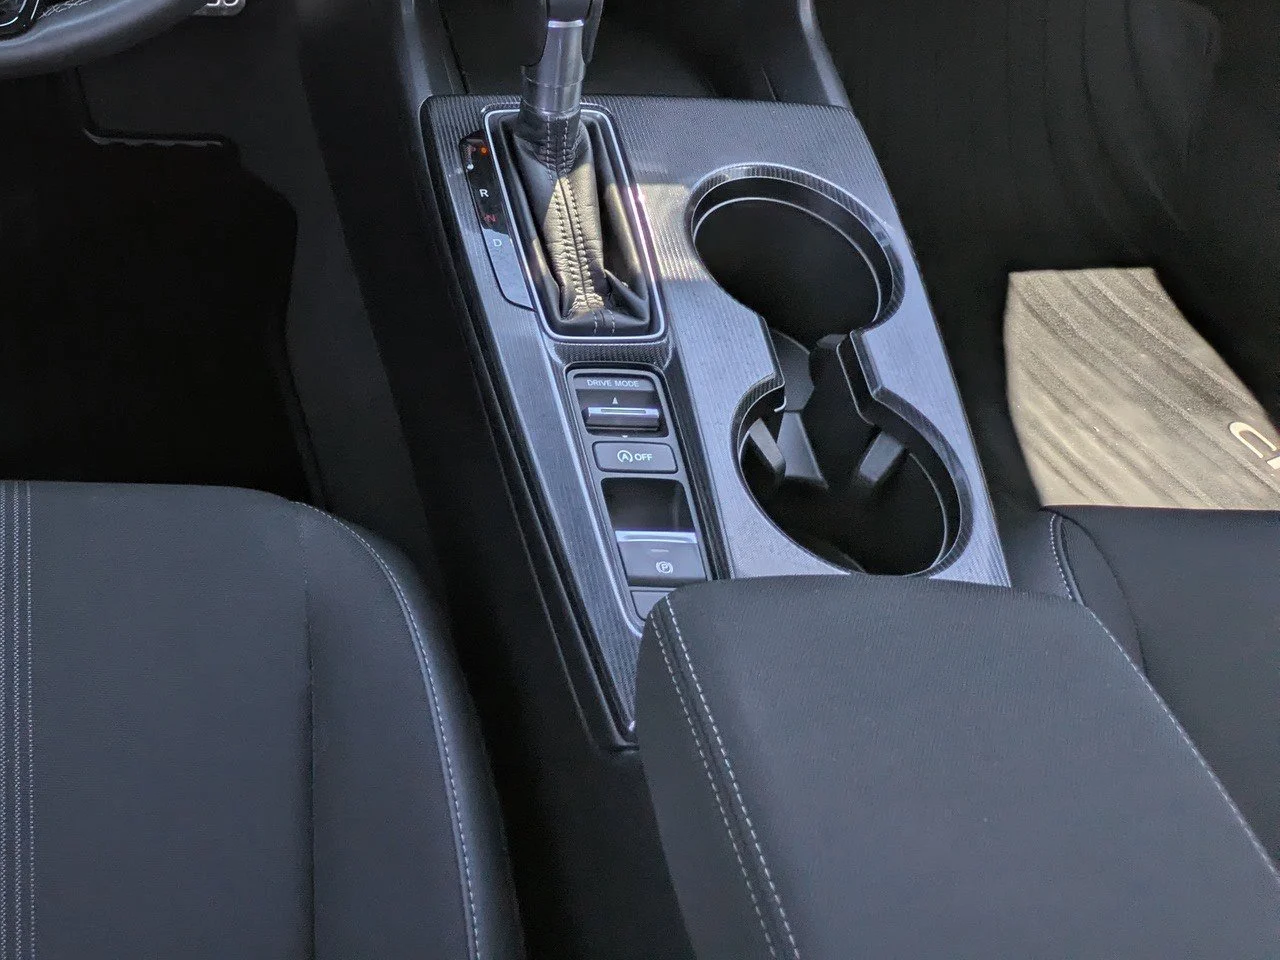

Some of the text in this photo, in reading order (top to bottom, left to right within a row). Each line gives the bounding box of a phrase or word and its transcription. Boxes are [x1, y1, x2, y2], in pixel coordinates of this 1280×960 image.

[479, 188, 489, 198] R
[493, 238, 502, 247] D
[587, 379, 612, 387] DRIVE
[635, 453, 652, 461] OFF
